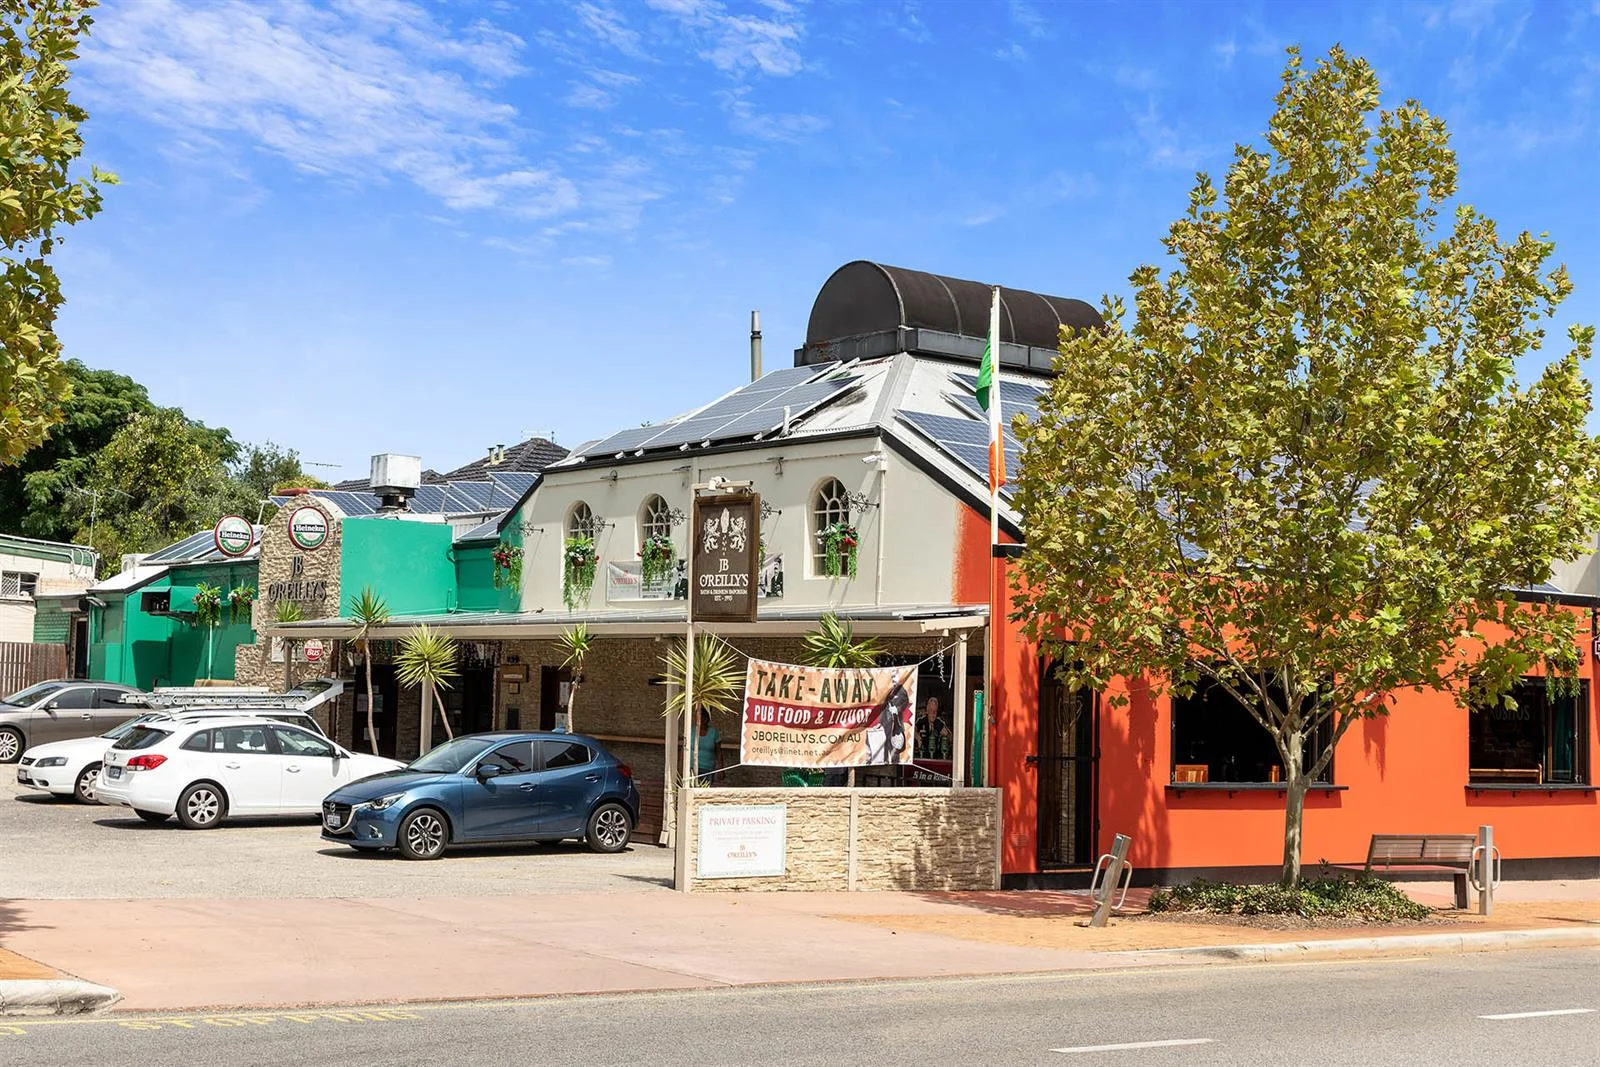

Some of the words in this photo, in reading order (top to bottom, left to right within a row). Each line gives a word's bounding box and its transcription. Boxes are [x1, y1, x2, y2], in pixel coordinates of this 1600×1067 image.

[221, 532, 250, 540] Heineken
[719, 558, 729, 573] JB
[756, 670, 875, 703] TAKE-AWAY
[754, 704, 774, 722] PUB
[777, 706, 811, 725] FOOD
[814, 709, 825, 725] &
[828, 708, 872, 726] LIQUOR
[709, 817, 740, 826] PRIVATE
[742, 816, 777, 825] PARKING
